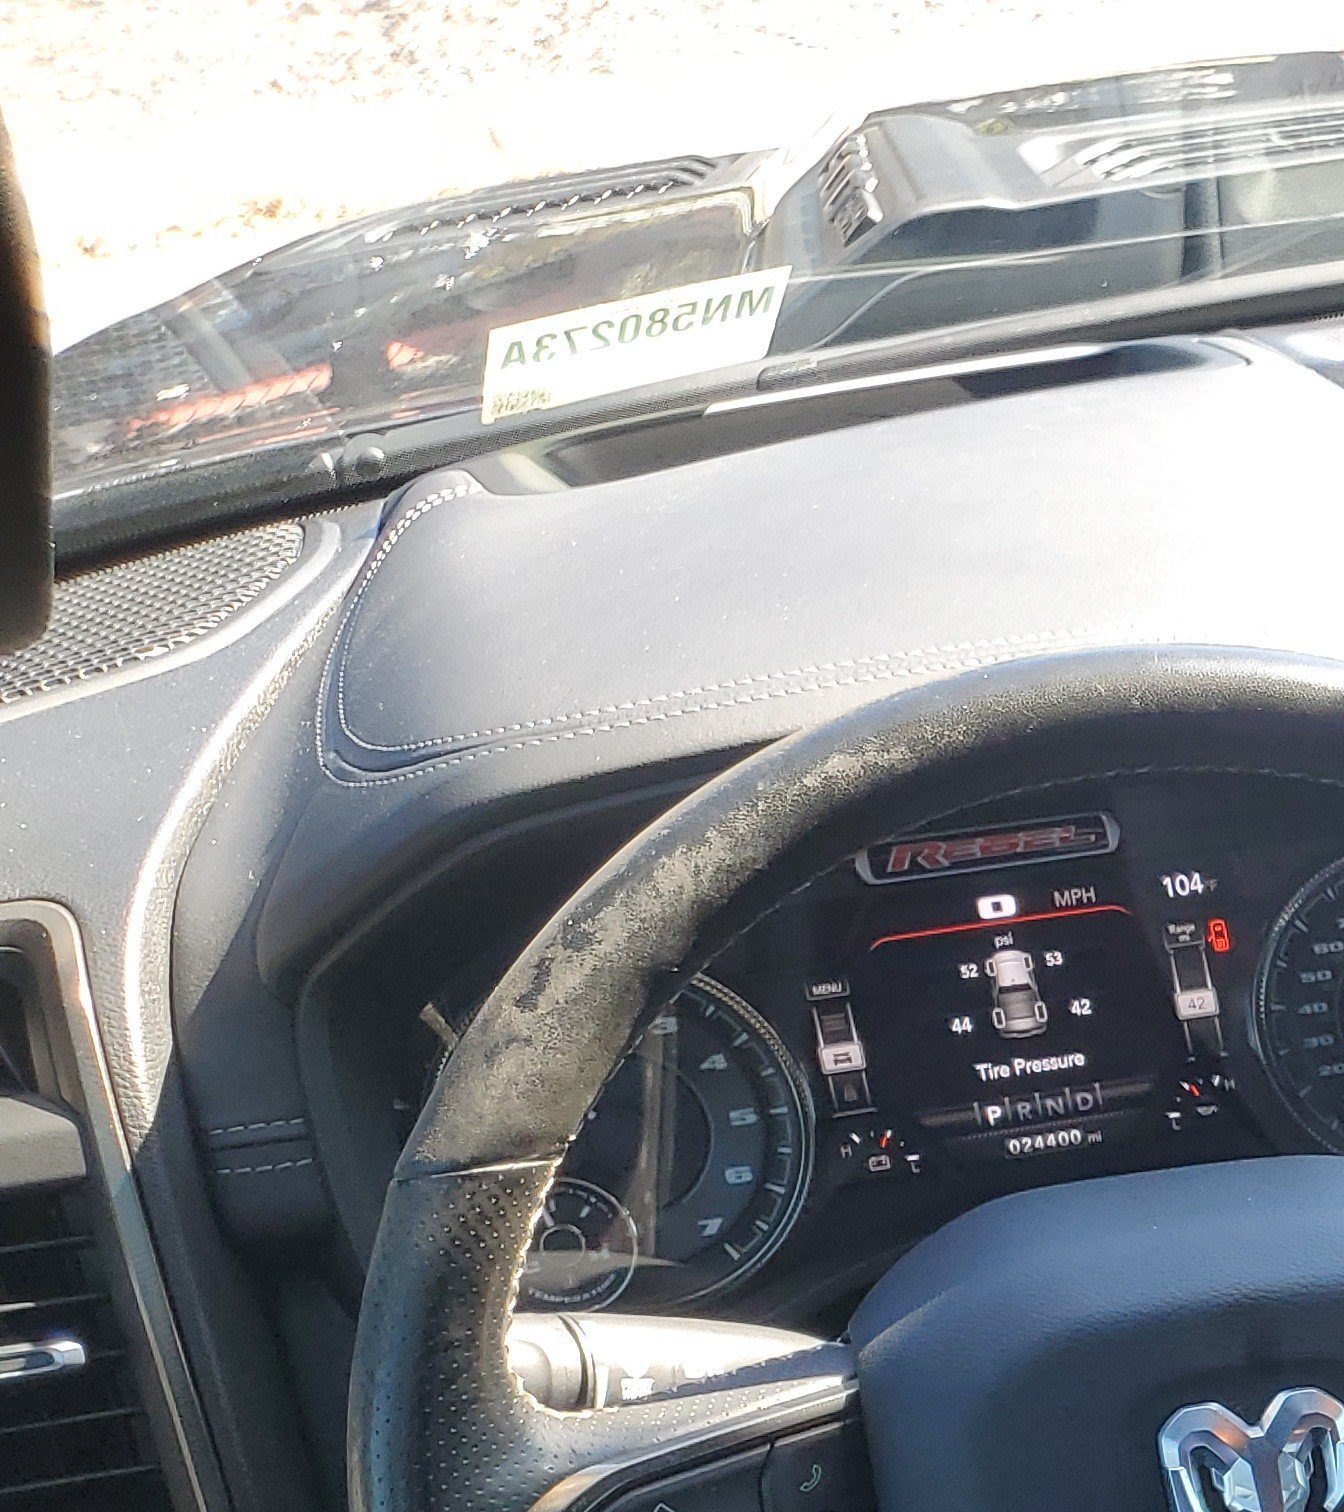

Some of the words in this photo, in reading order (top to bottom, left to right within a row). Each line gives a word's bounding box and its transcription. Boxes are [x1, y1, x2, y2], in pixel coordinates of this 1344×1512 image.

[886, 825, 1096, 873] REBEL
[1053, 886, 1097, 909] MPH
[993, 931, 1014, 949] psi
[1044, 951, 1064, 967] 53
[959, 964, 979, 979] 52
[1070, 999, 1093, 1017] 42
[1187, 997, 1205, 1011] 42
[1298, 1001, 1328, 1016] 40
[950, 1016, 974, 1034] 44
[700, 1053, 728, 1071] 4
[975, 1063, 1011, 1082] Tire
[1015, 1051, 1086, 1077] Pressure
[729, 1108, 758, 1126] 5
[986, 1106, 1002, 1127] P
[1018, 1101, 1033, 1120] R
[1046, 1096, 1065, 1116] N
[1076, 1091, 1094, 1111] D
[1009, 1129, 1083, 1156] 024400
[725, 1166, 753, 1184] 6
[698, 1217, 724, 1236] 7
